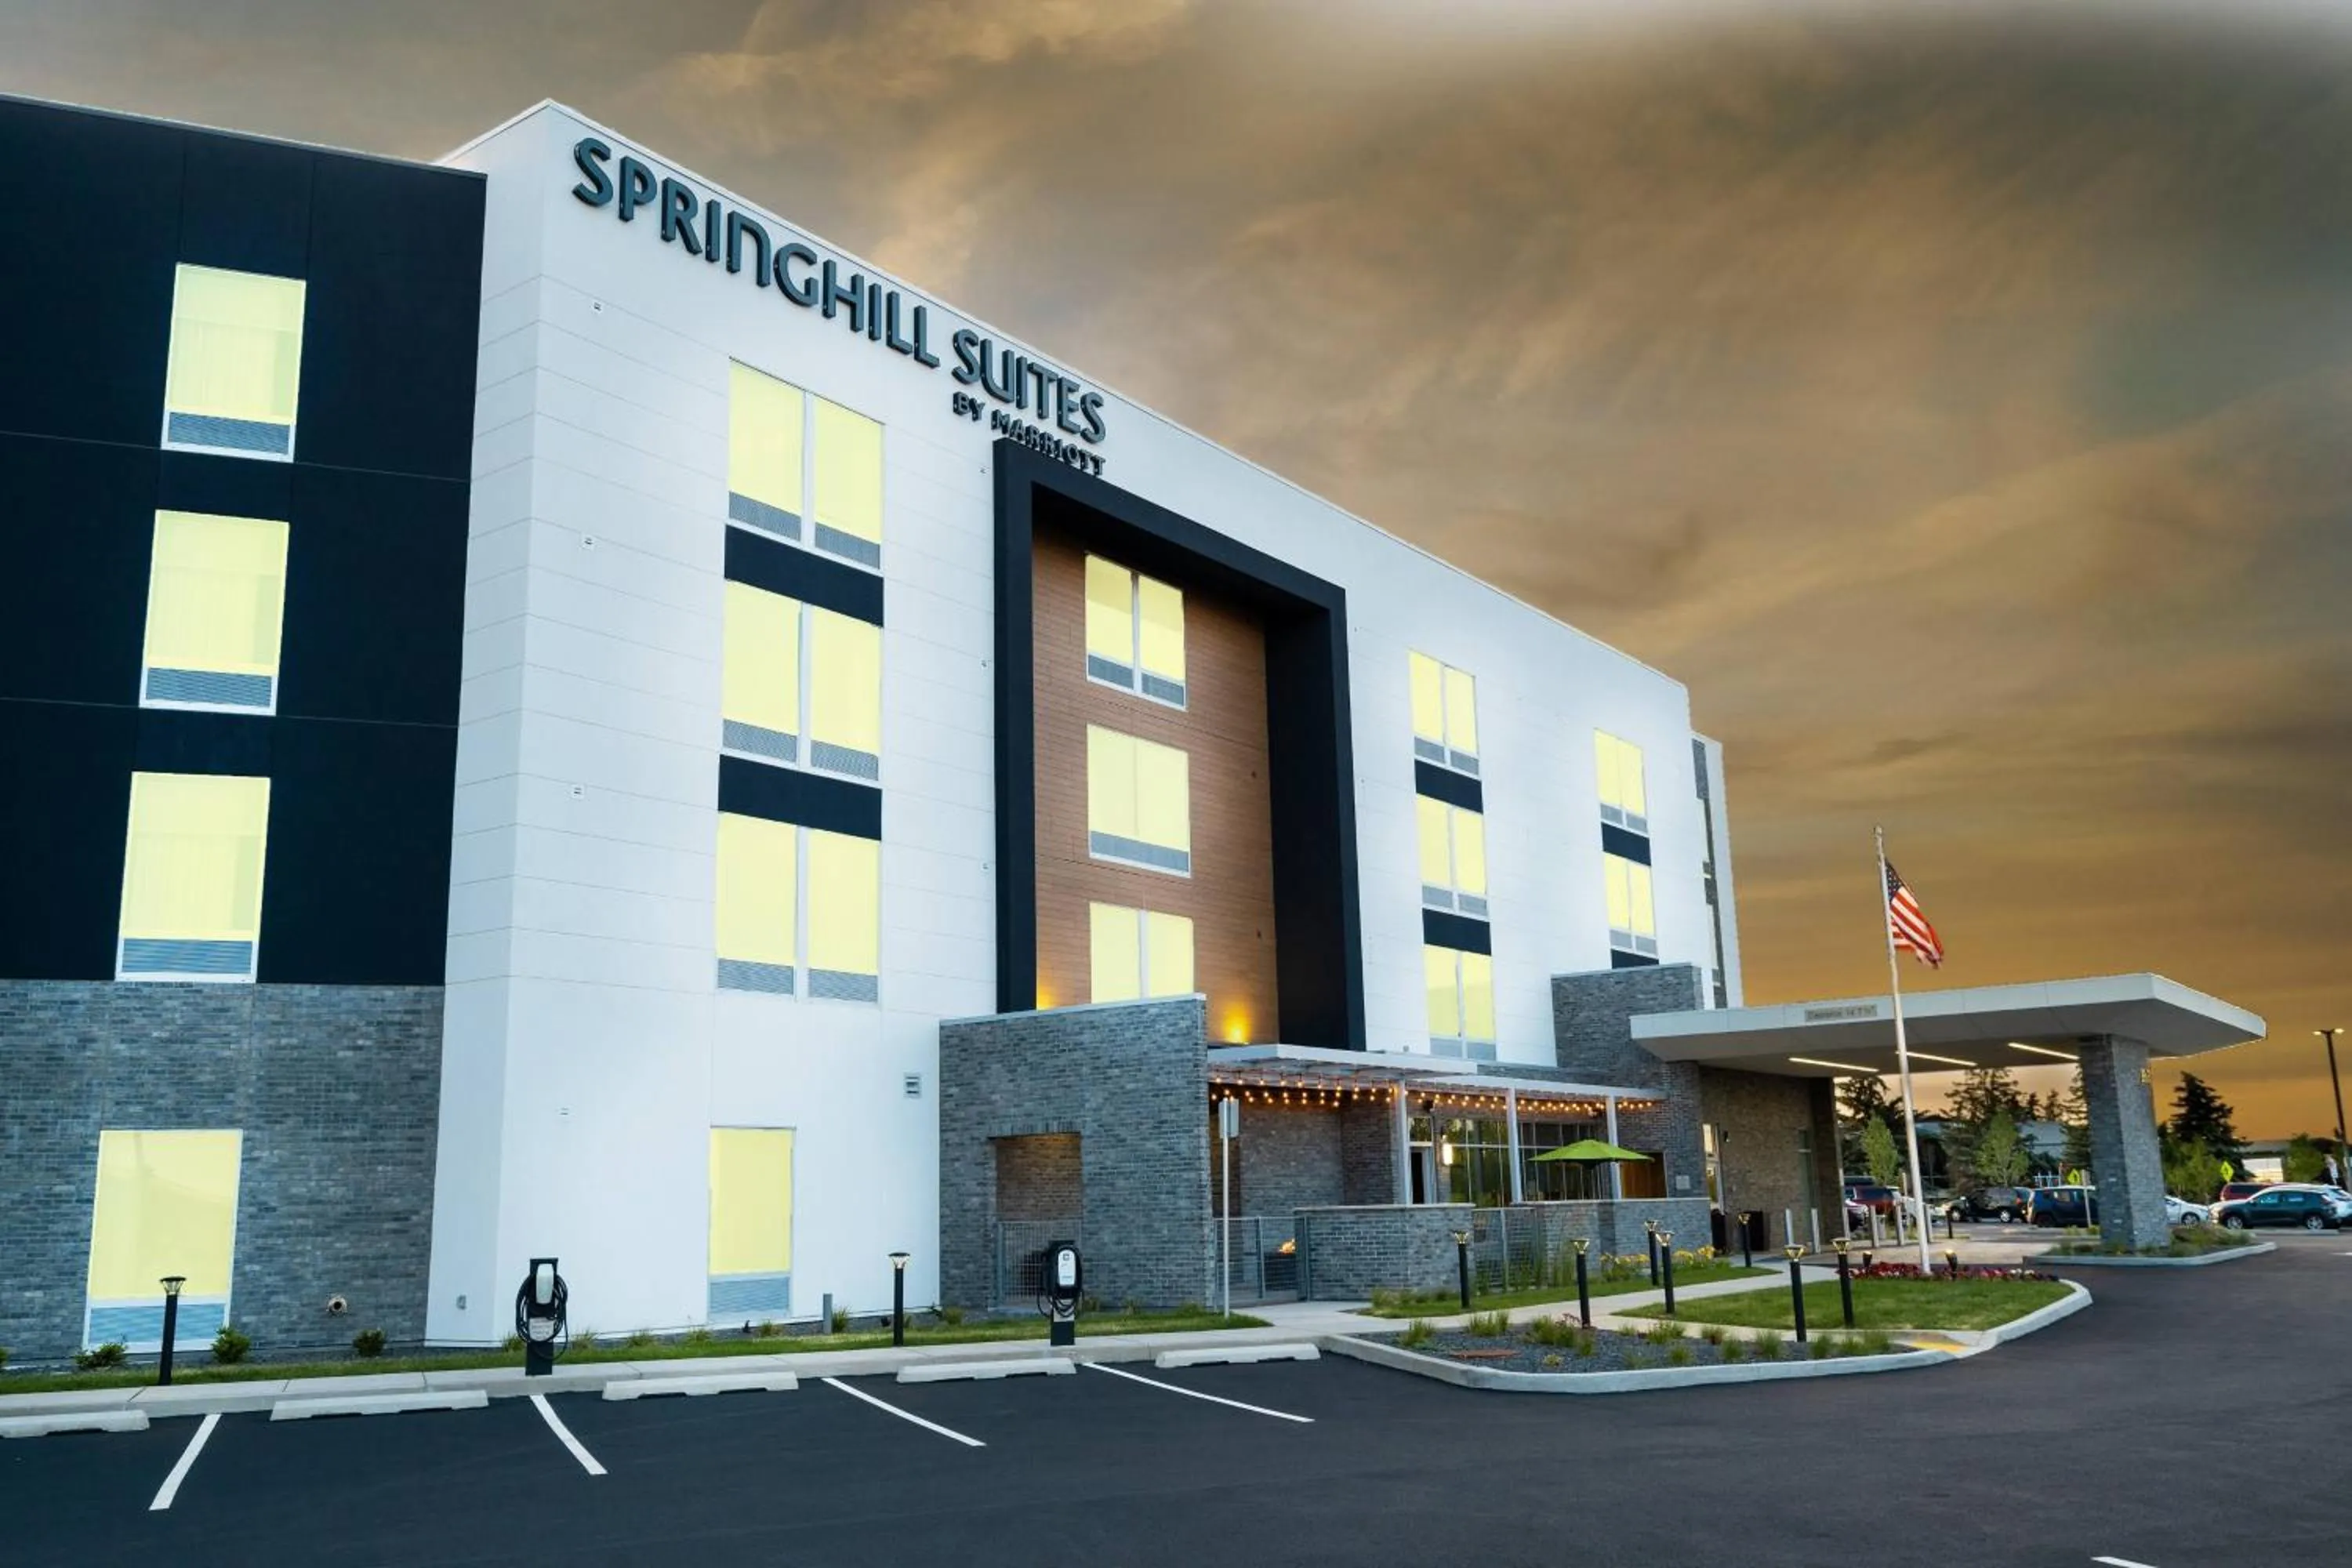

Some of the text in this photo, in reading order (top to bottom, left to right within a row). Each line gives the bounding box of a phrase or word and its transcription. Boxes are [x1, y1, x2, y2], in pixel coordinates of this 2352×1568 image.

[572, 136, 1107, 445] SPRINGHILL SUITES
[953, 392, 1107, 477] BY MARRIOTT
